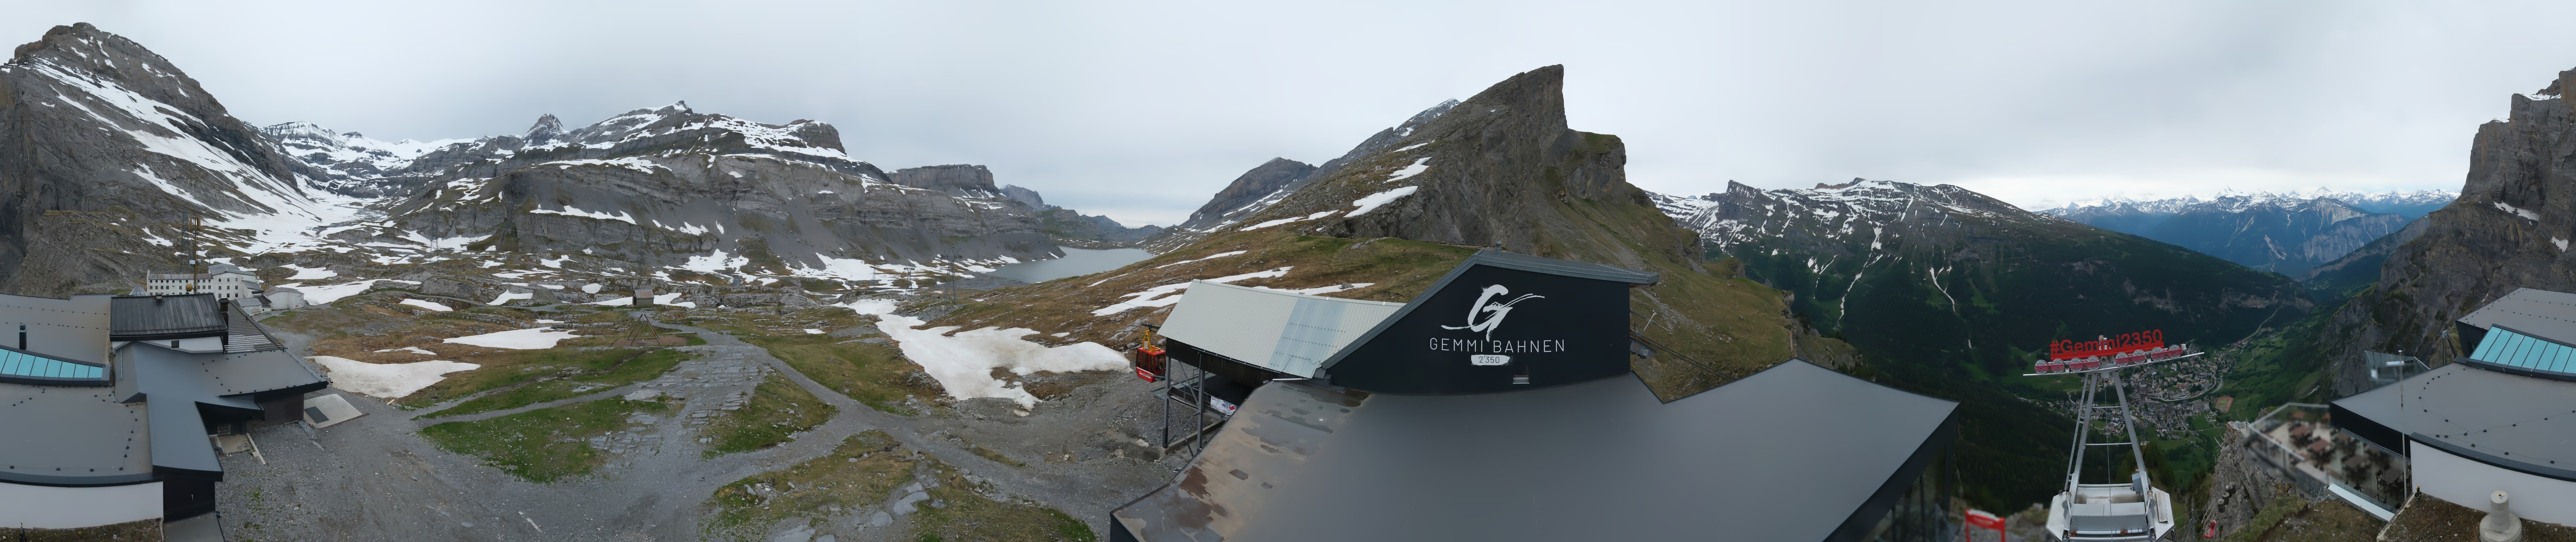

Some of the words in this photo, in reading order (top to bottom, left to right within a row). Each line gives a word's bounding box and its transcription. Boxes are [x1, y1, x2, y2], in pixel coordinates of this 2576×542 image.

[1430, 338, 1482, 352] GEMMI
[1493, 340, 1564, 353] BAHNEN
[2050, 329, 2162, 354] #Gemmi2350
